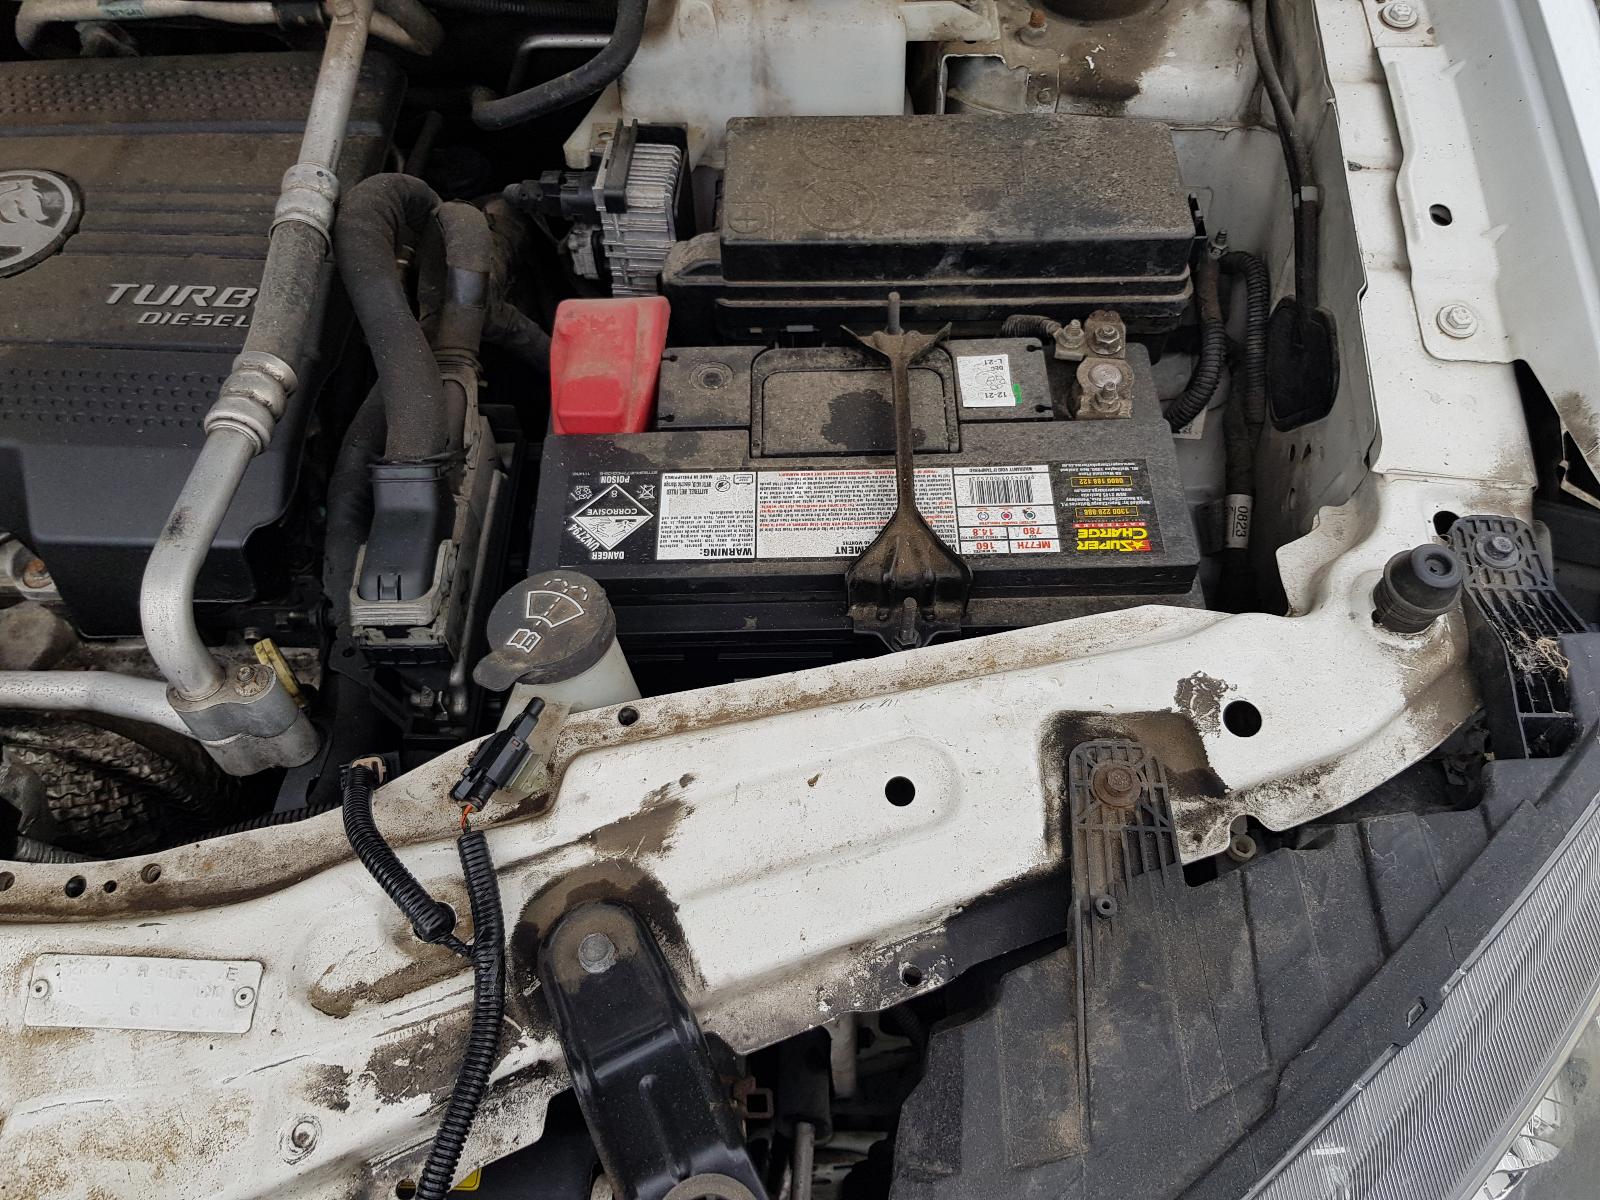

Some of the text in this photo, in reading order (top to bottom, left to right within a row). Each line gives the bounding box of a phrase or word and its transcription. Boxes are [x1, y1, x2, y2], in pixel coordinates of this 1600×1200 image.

[105, 283, 258, 307] TURB
[138, 312, 250, 327] DIESEL
[611, 490, 618, 498] 8
[1235, 505, 1248, 537] 0823
[568, 523, 600, 551] UN2794
[1077, 528, 1147, 539] CHARGE
[1017, 541, 1050, 549] MF77H
[592, 551, 624, 559] DANGER
[700, 548, 752, 556] WARNING:
